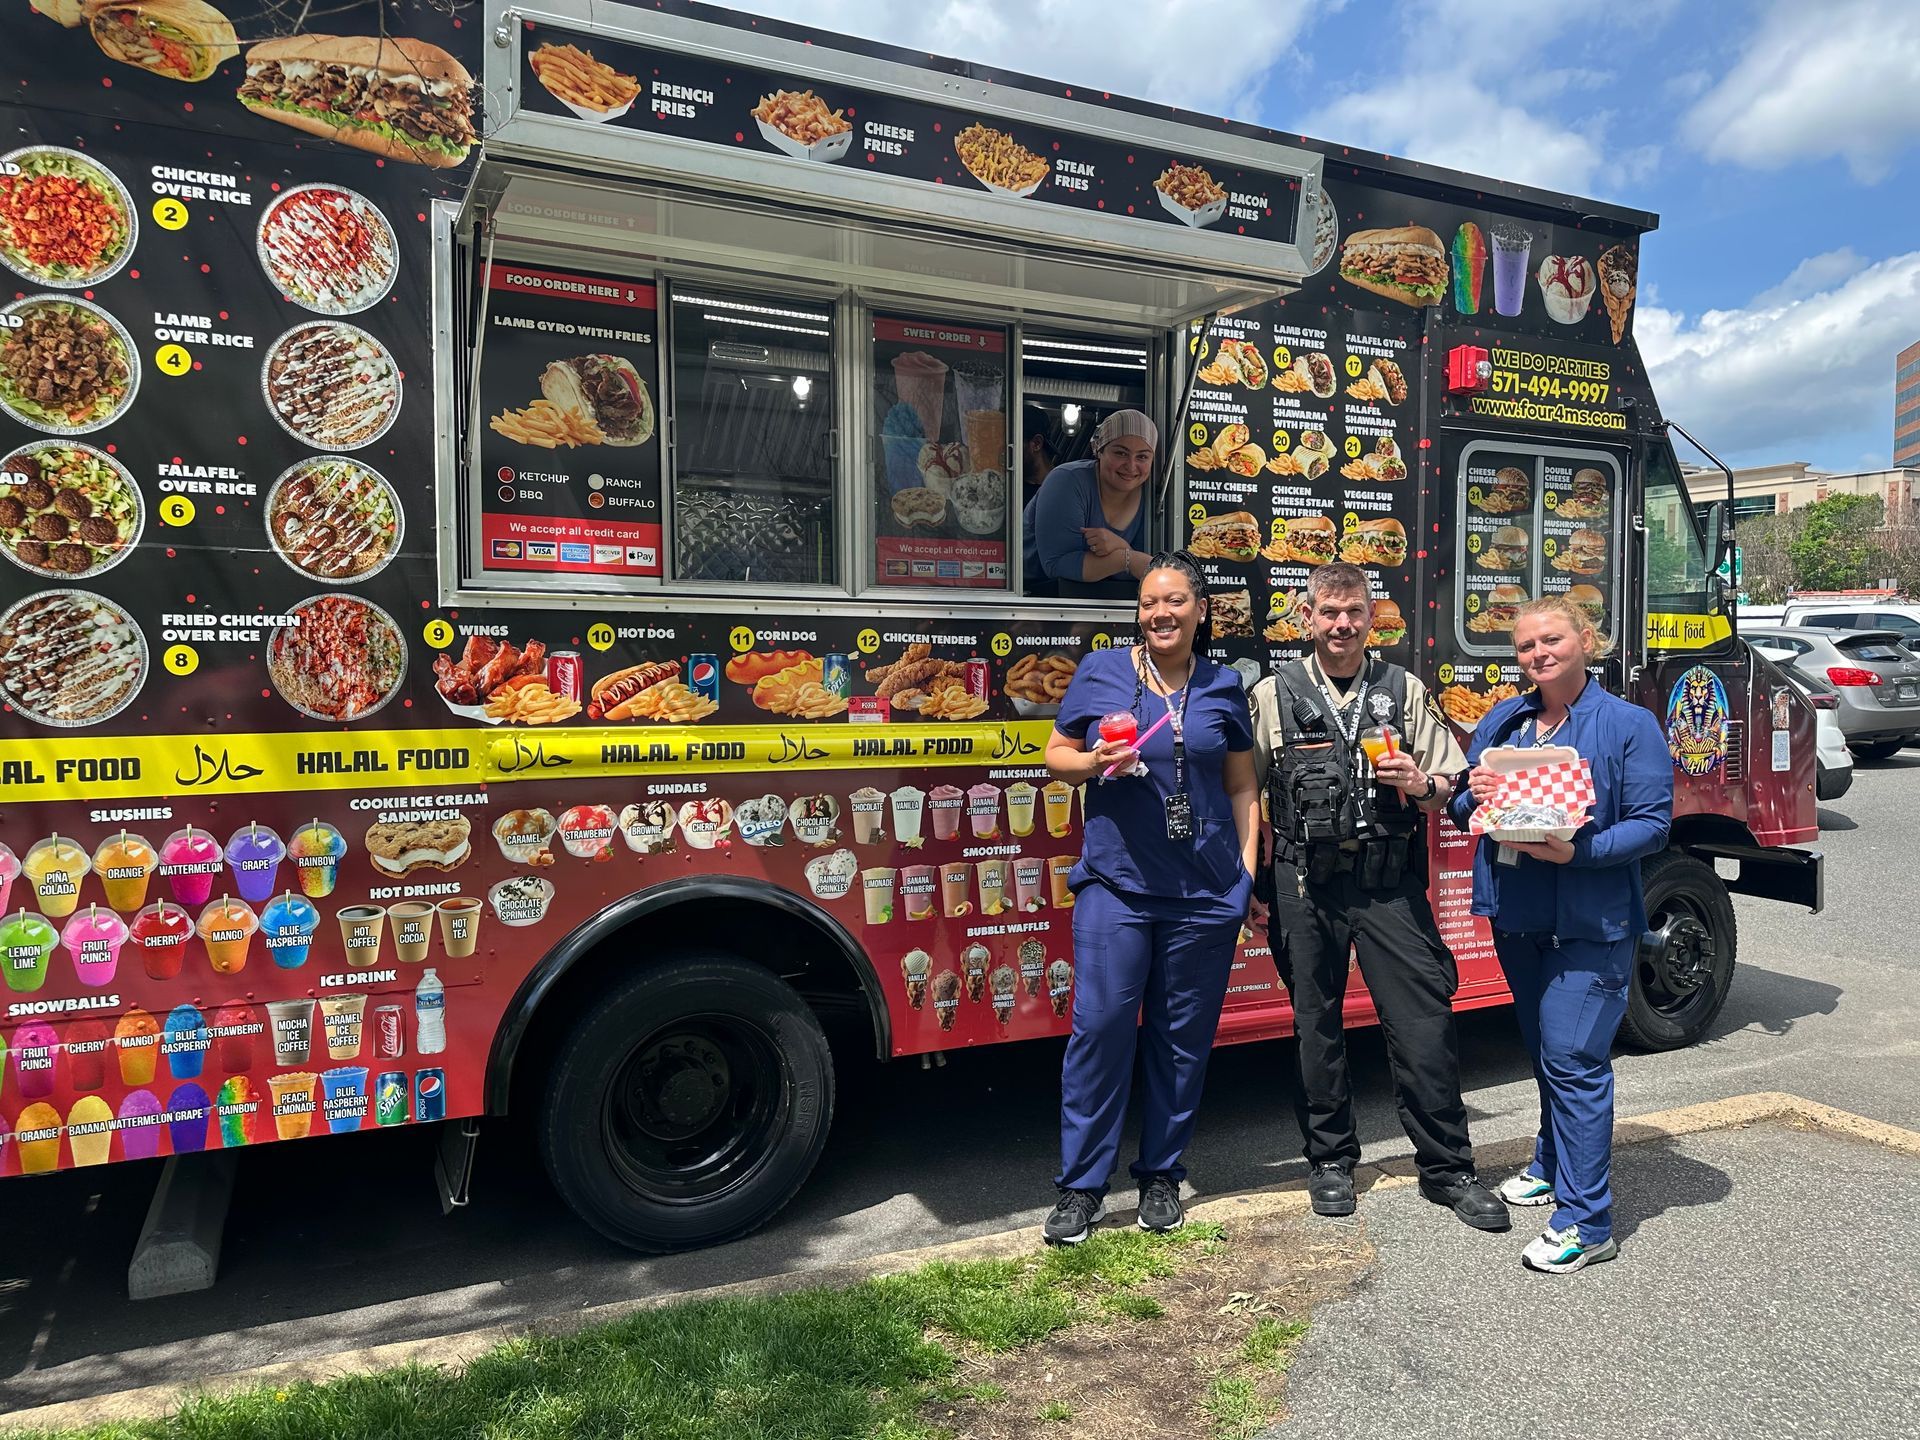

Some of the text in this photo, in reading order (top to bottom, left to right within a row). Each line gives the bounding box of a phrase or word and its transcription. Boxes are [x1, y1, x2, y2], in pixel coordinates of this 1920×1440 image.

[652, 81, 714, 106] FRENCH
[652, 98, 696, 119] FRIES
[864, 121, 915, 143] CHEESE
[863, 136, 902, 157] FRIES
[1056, 158, 1095, 178] STEAK
[152, 165, 236, 188] CHICKEN
[1055, 174, 1089, 192] FRIES
[152, 181, 252, 205] OVER RICE
[1230, 191, 1268, 210] BACON
[164, 206, 178, 222] 2
[1228, 205, 1259, 222] FRIES
[506, 274, 620, 298] FOOD ORDER HERE
[154, 312, 212, 329] LAMB
[494, 316, 652, 344] LAMB GYRO WITH FRIES
[904, 328, 971, 343] SWEET ORDER
[1274, 324, 1327, 339] LAMB GYRO
[154, 328, 254, 348] OVER RICE
[1274, 335, 1325, 350] WITH FRIES
[166, 352, 181, 367] 4
[1492, 348, 1610, 380] WE DO PARTIES
[1491, 371, 1610, 404] 571-494-9997
[1345, 404, 1382, 416] FALAFEL
[1472, 398, 1626, 430] www.four4ms.com
[1344, 414, 1396, 428] SHAWARMA
[1275, 436, 1288, 446] 20
[158, 463, 239, 480] FALAFEL
[519, 472, 570, 484] KETCHUP
[1468, 468, 1496, 476] CHEESE
[606, 478, 642, 488] RANCH
[1188, 480, 1258, 493] PHILLY CHEESE
[1468, 476, 1498, 484] BURGER
[158, 479, 257, 496] OVER RICE
[1272, 485, 1312, 496] CHICKEN
[519, 490, 544, 500] BBQ
[1272, 496, 1334, 508] CHEESE STEAK
[1344, 490, 1394, 501] VEGGIE SUB
[1470, 490, 1480, 500] 31
[608, 498, 655, 508] BUFFALO
[172, 504, 184, 519] 6
[510, 522, 640, 539] We accept all credit card
[636, 552, 654, 562] Pay
[162, 614, 300, 628] FRIED CHICKEN
[162, 630, 260, 642] OVER RICE
[432, 627, 445, 641] 9
[458, 624, 509, 637] WINGS
[591, 630, 612, 644] 10
[618, 628, 676, 640] HOT DOG
[756, 630, 817, 642] CORN DOG
[733, 632, 750, 646] 11
[860, 635, 878, 647] 12
[883, 632, 978, 646] CHICKEN TENDERS
[994, 639, 1010, 650] 13
[1016, 635, 1082, 646] ONION RINGS
[175, 653, 188, 669] 8
[1440, 668, 1452, 678] 37
[1454, 666, 1483, 674] FRENCH
[1454, 674, 1475, 682] FRIES
[768, 732, 830, 764] حلال
[852, 737, 974, 758] HALAL FOOD
[992, 728, 1042, 759] حلال
[497, 736, 574, 773] حلال
[601, 742, 746, 764] HALAL FOOD
[175, 743, 265, 787] حلال
[296, 748, 470, 774] HALAL FOOD
[56, 757, 141, 783] FOOD
[647, 783, 708, 795] SUNDAES
[350, 793, 488, 810] COOKIE ICE CREAM
[928, 800, 964, 809] STRAWBERRY
[90, 807, 173, 823] SLUSHIES
[378, 809, 460, 824] SANDWICH
[796, 817, 830, 827] CHOCOLATE
[564, 828, 612, 840] STRAWBERRY
[632, 825, 662, 836] BROWNIE
[692, 822, 718, 833] CHERRY
[807, 827, 820, 836] NUT
[506, 834, 541, 846] CARAMEL
[962, 845, 1022, 858] SMOOTHIES
[159, 862, 224, 876] WATTERMELON
[242, 859, 270, 871] GRAPE
[298, 856, 336, 868] RAINBOW
[46, 871, 68, 884] PIÑA
[107, 866, 144, 880] ORANGE
[946, 874, 965, 882] PEACH
[39, 884, 76, 896] COLADA
[370, 882, 462, 900] HOT DRINKS
[500, 899, 542, 911] CHOCOLATE
[1439, 898, 1460, 907] minced
[501, 909, 542, 921] SPRINKLES
[280, 926, 300, 936] BLUE
[967, 922, 1050, 937] BUBBLE WAFFLES
[1439, 921, 1462, 930] cilantro
[212, 930, 242, 942] MANGO
[266, 936, 314, 948] RASPBERRY
[8, 946, 41, 958] LEMON
[1458, 940, 1494, 950] in pita bread
[14, 958, 36, 970] LIME
[320, 970, 397, 987] ICE DRINK
[8, 994, 120, 1017] SNOWBALLS
[208, 1022, 264, 1038] STRAWBERRY
[69, 1109, 203, 1136] BANANA WATTERMELON GRAPE
